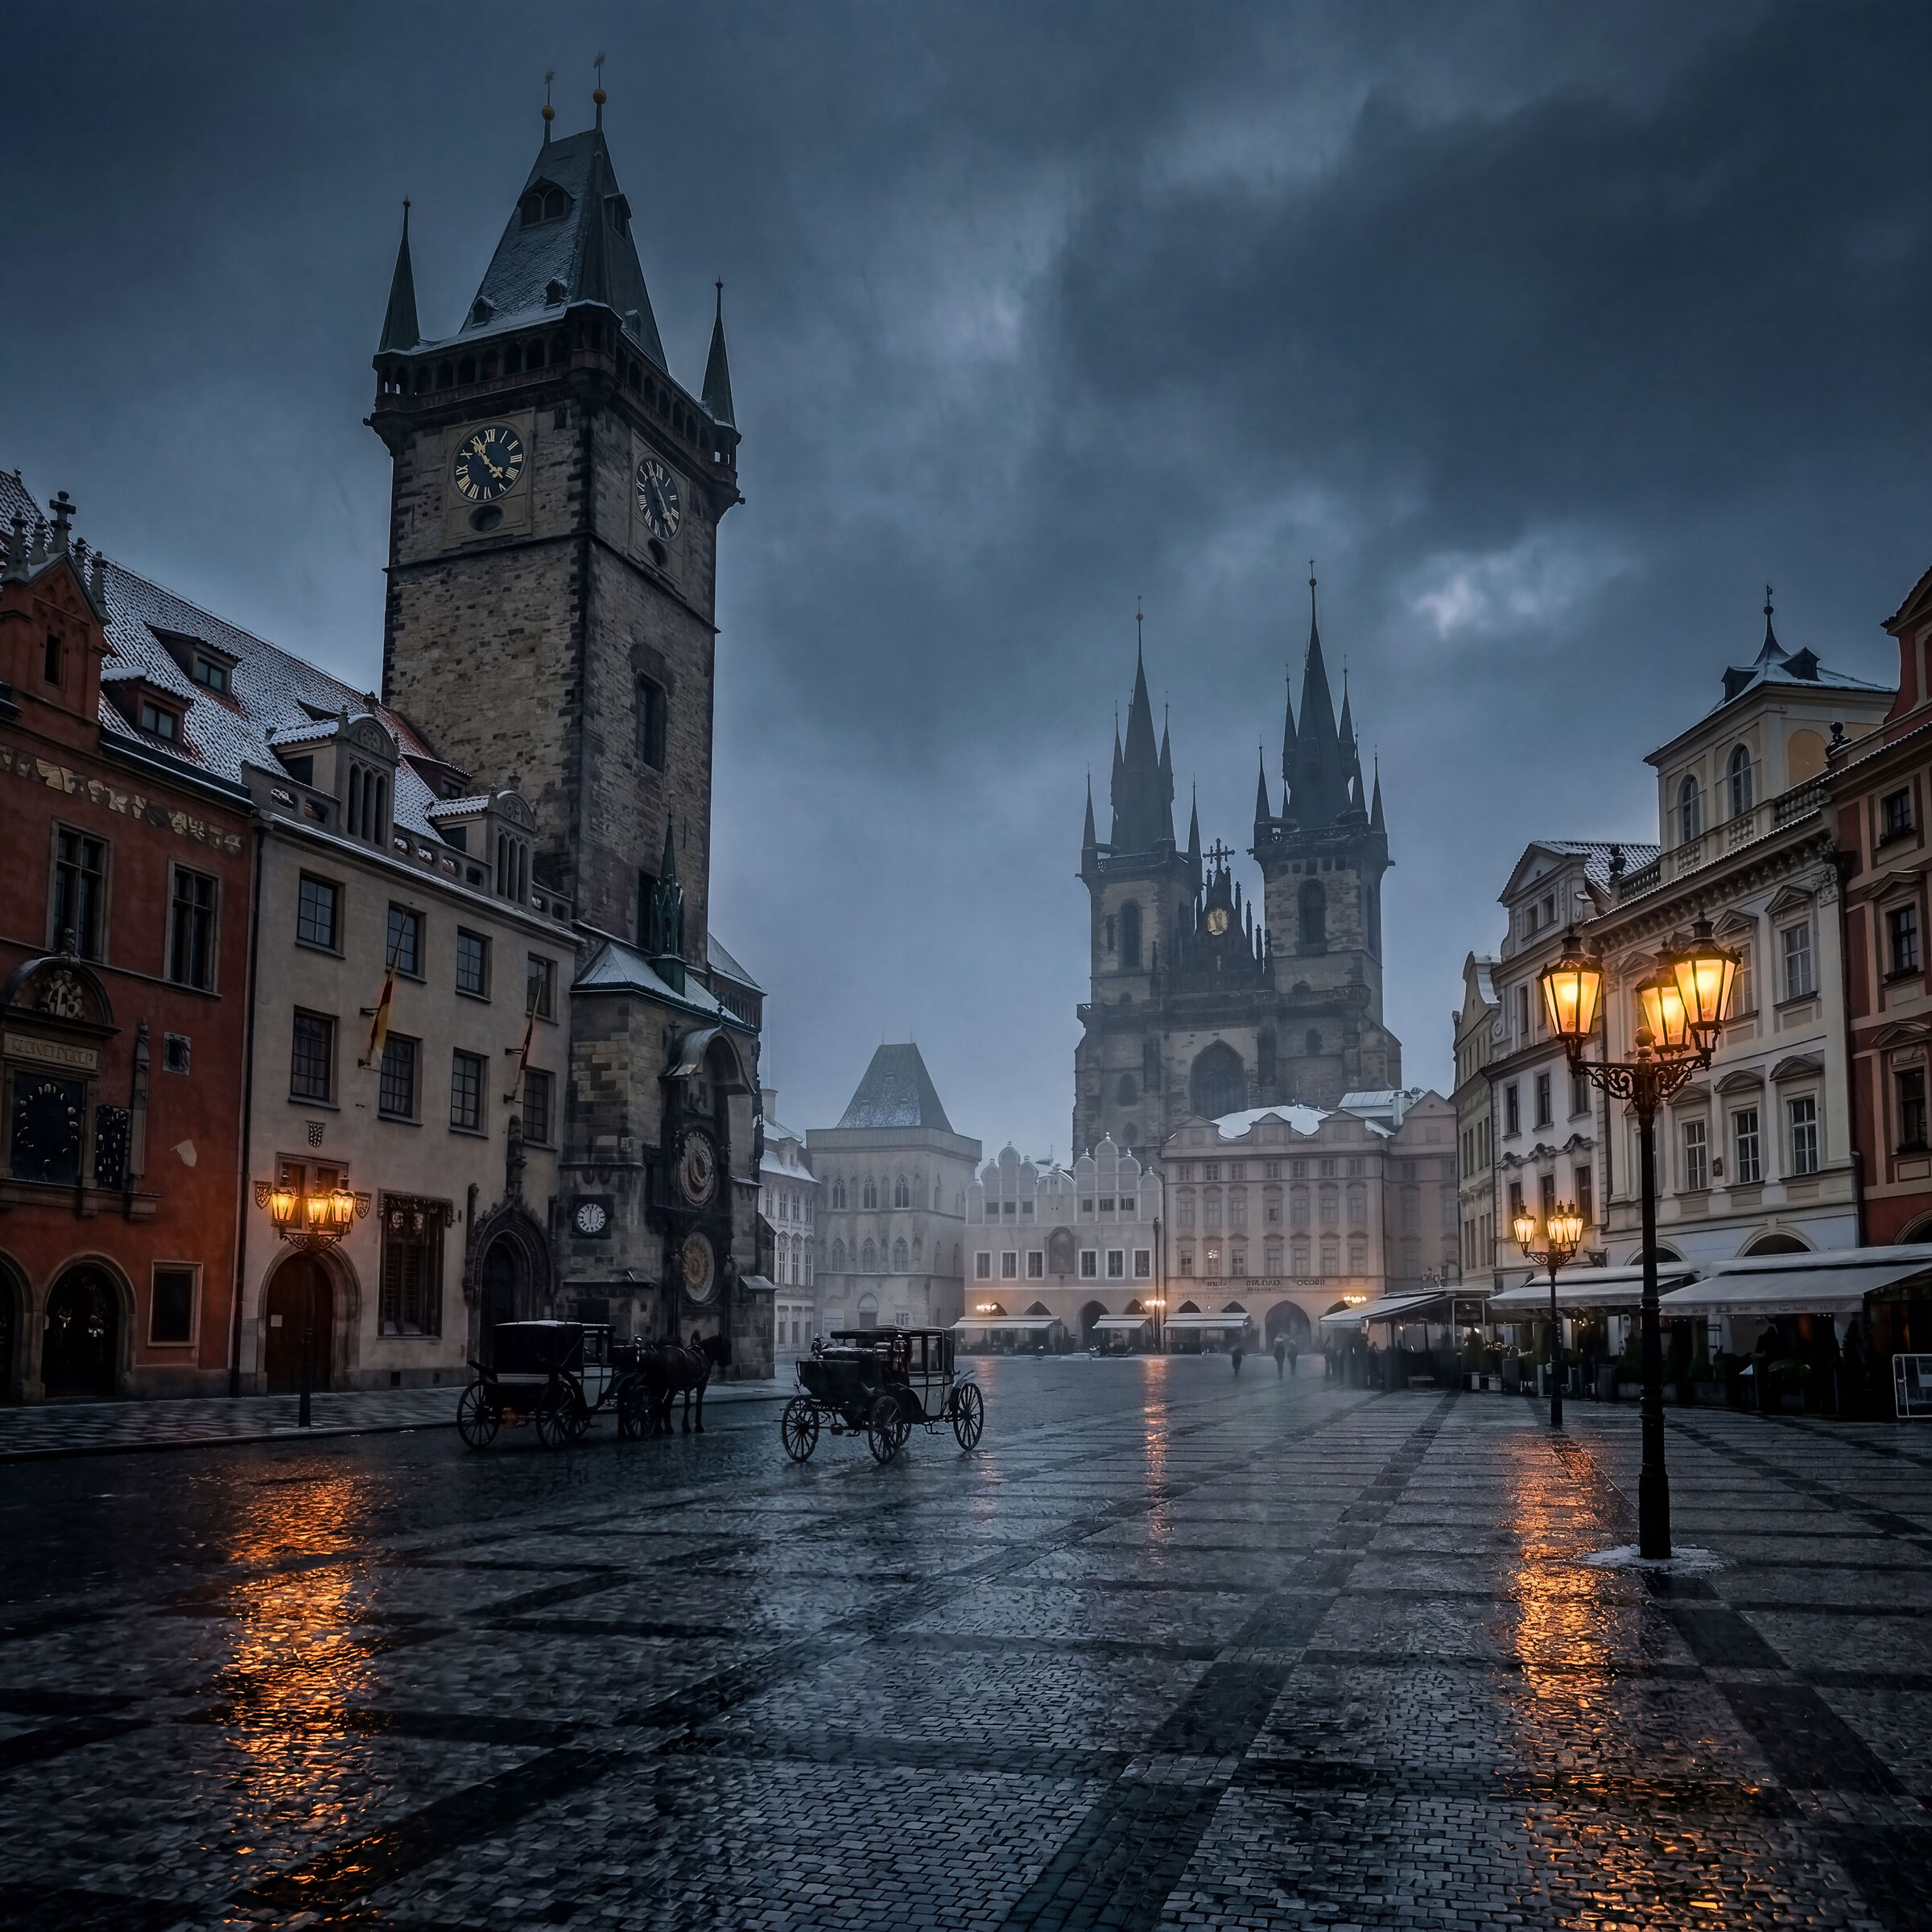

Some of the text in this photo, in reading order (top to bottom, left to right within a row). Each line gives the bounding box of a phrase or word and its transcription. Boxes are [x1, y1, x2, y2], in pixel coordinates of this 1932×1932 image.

[500, 431, 508, 444] I
[507, 440, 519, 451] II
[460, 449, 473, 460] X
[510, 454, 522, 464] III
